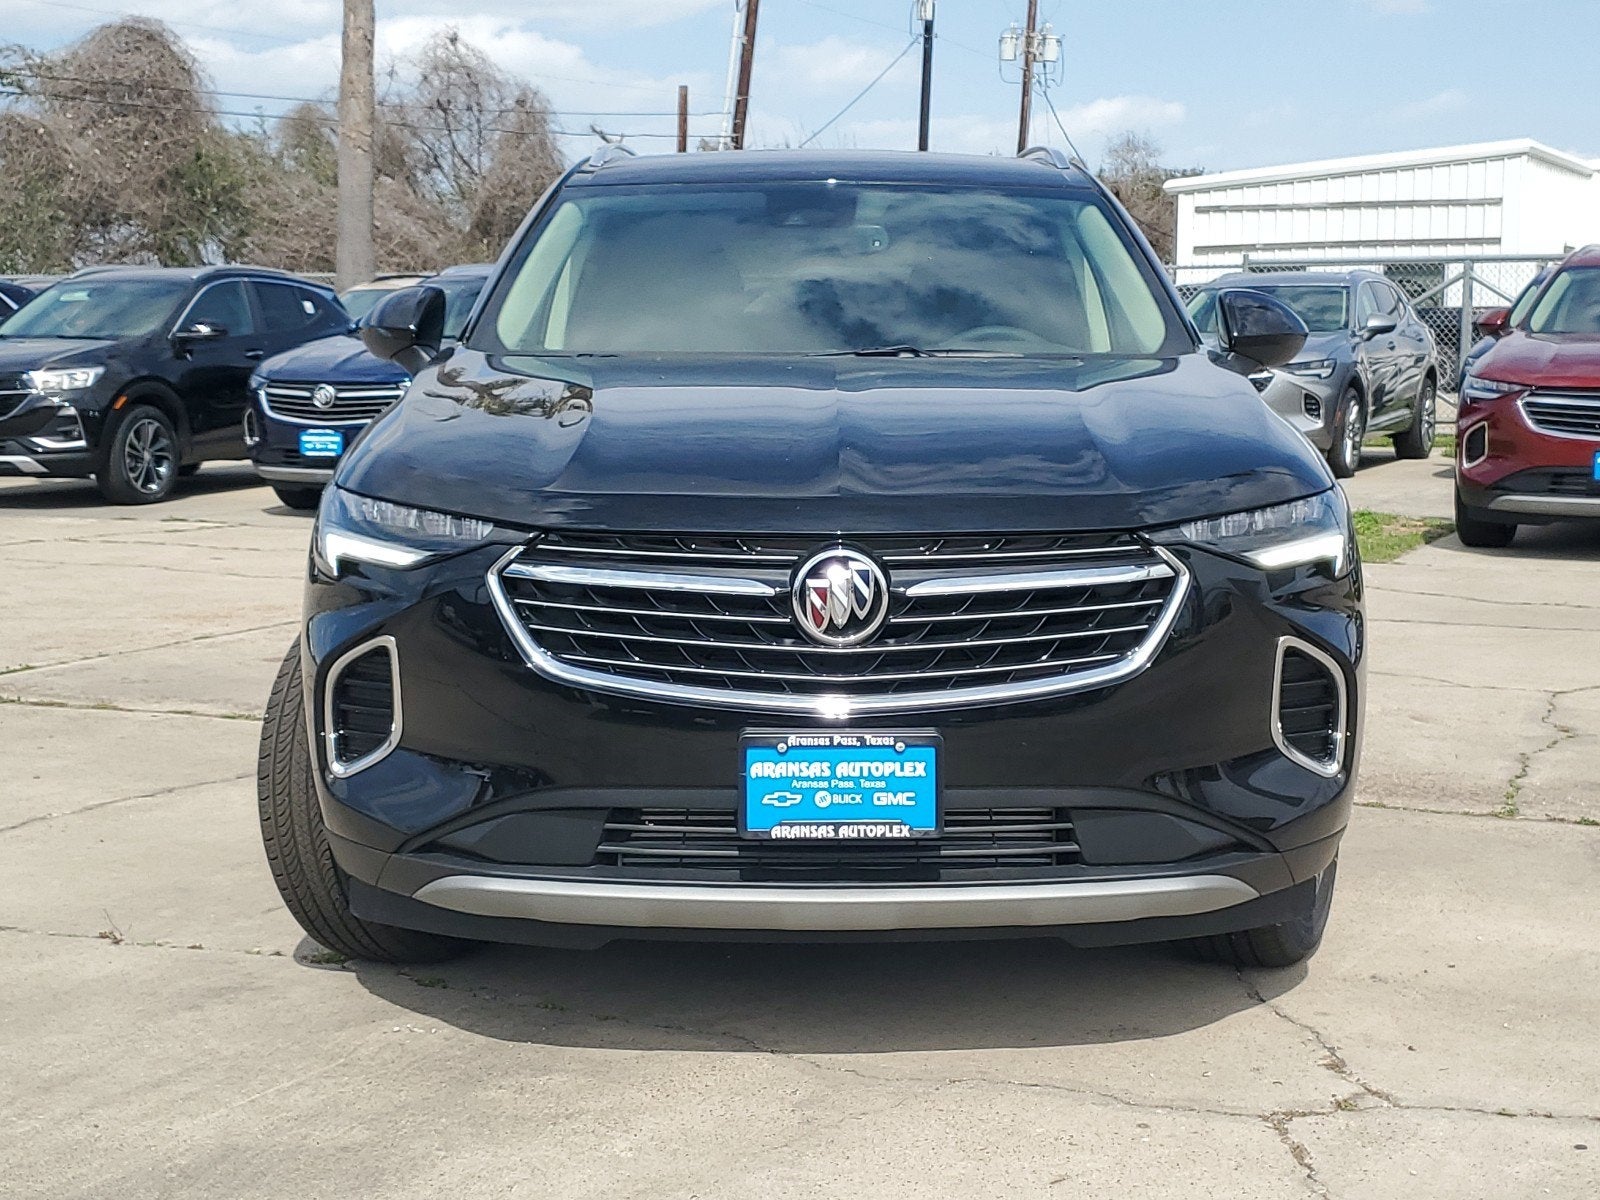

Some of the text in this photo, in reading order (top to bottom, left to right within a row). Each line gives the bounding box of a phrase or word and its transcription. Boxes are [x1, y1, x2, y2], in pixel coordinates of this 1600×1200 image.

[787, 735, 895, 746] Aransas Pass, Texas
[750, 762, 927, 779] ARANSAS AUTOPLEX
[791, 779, 887, 789] Aransas Pass, Texas
[833, 792, 916, 806] BUICK GMC
[771, 825, 911, 839] ARANSAS AUTOPLEX
